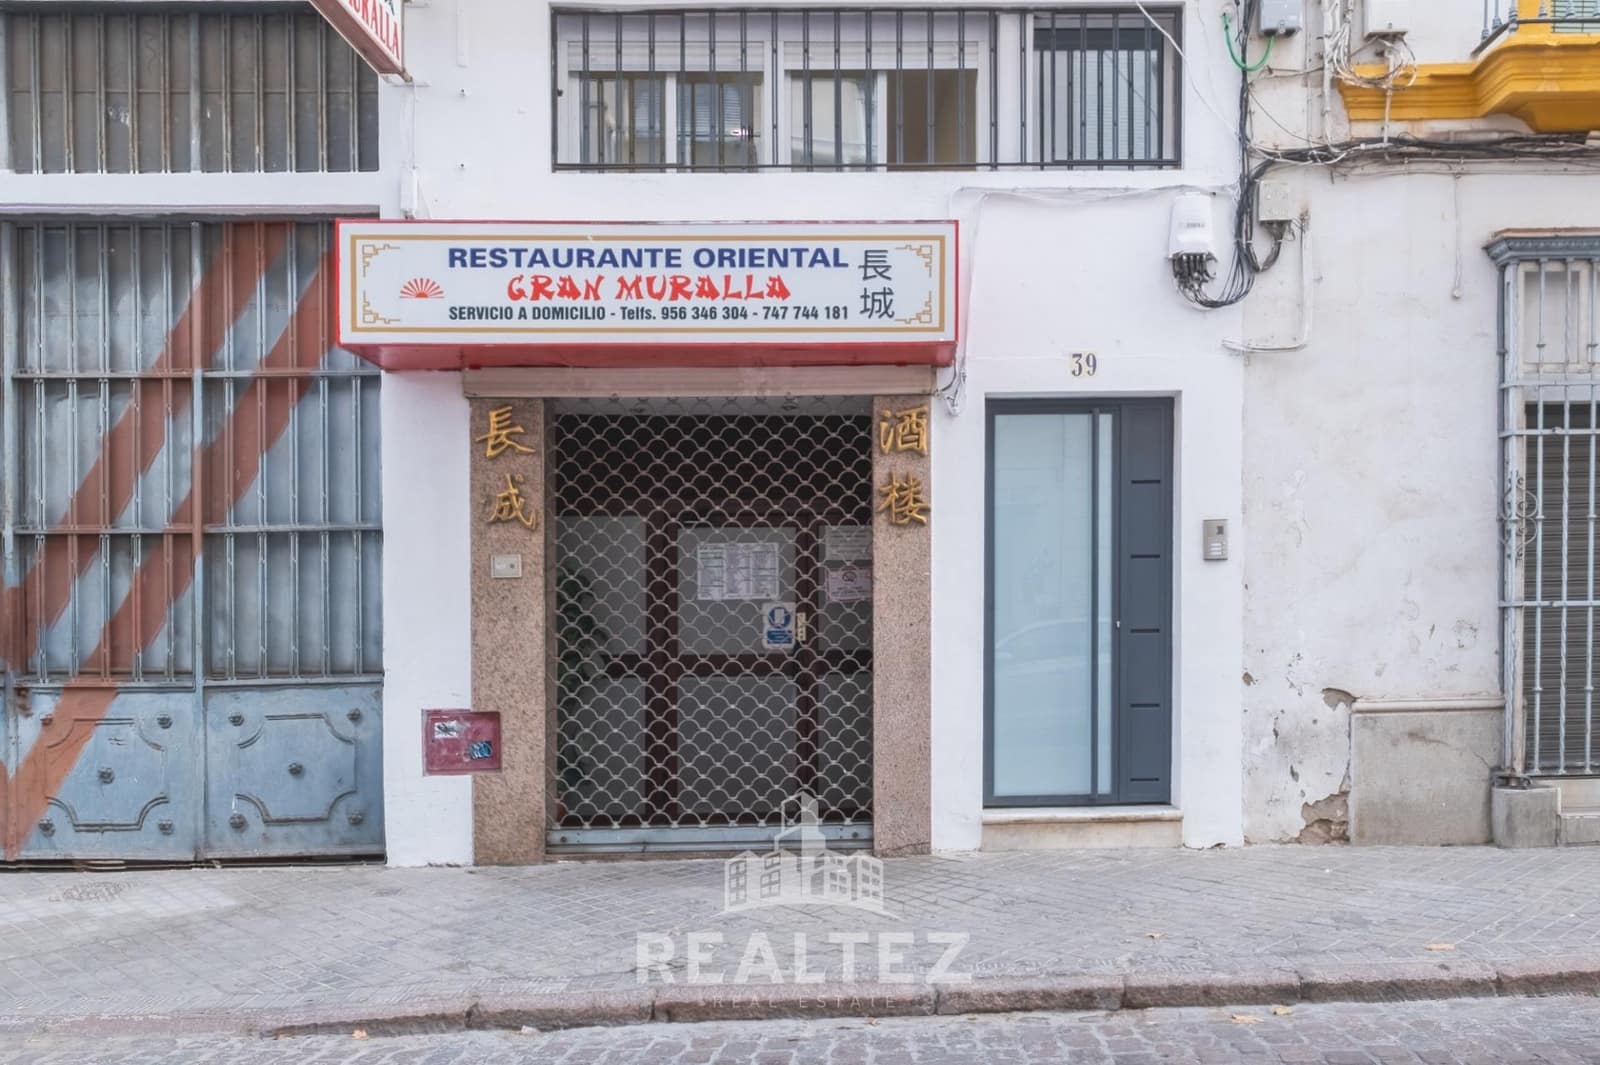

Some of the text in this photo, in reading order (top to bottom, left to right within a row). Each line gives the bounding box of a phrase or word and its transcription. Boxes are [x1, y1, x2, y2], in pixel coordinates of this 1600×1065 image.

[349, 0, 400, 61] RALLA
[448, 247, 849, 268] RESTAURANTE ORIENTAL
[507, 274, 791, 301] GRAN MURALLA
[858, 249, 895, 319] 長城
[449, 306, 513, 320] SERVICIO
[518, 306, 528, 320] A
[533, 306, 605, 320] DOMICILIO
[620, 306, 657, 320] Telfs.
[661, 306, 687, 320] 956
[692, 306, 718, 320] 346
[722, 306, 748, 320] 304
[762, 306, 788, 320] 747
[793, 306, 819, 320] 744
[825, 306, 848, 320] 181
[1072, 353, 1097, 376] 39
[878, 407, 930, 525] 酒楼
